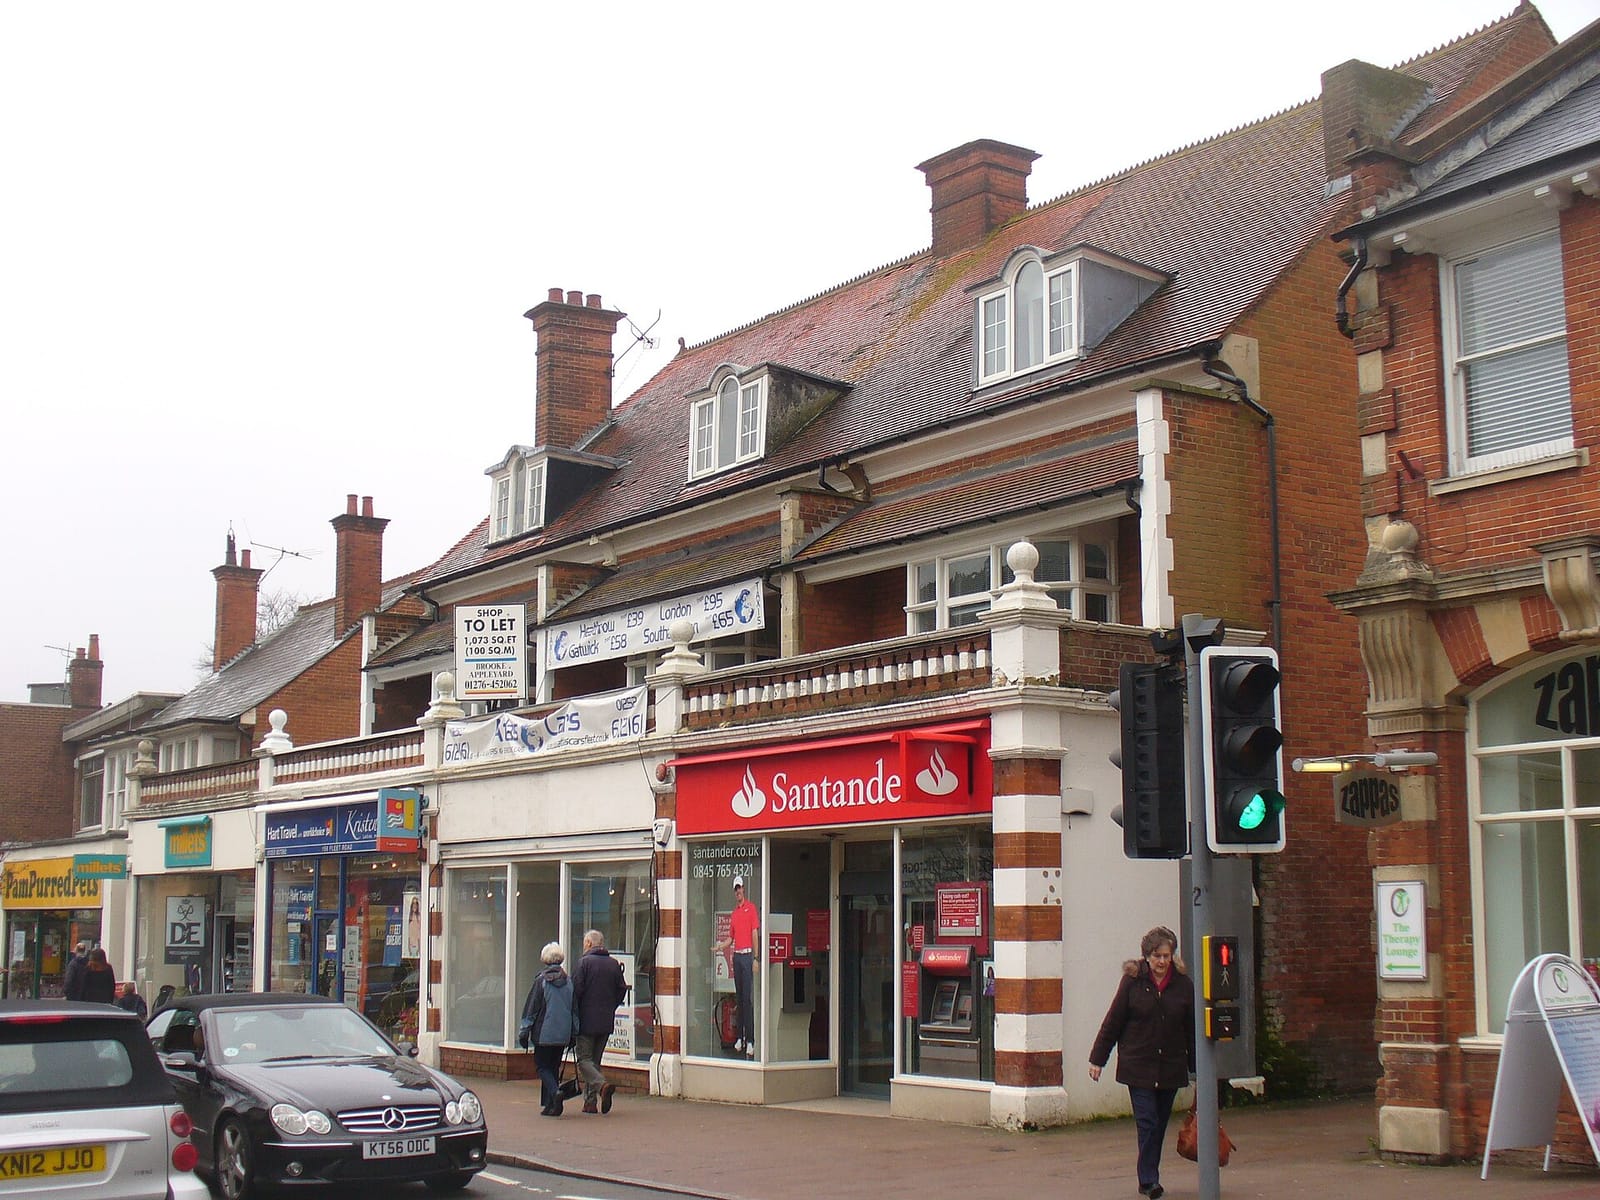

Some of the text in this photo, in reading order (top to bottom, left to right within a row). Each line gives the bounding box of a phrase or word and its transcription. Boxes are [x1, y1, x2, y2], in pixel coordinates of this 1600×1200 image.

[477, 609, 503, 617] SHOP
[626, 610, 645, 629] £39
[659, 602, 692, 621] London
[703, 592, 724, 612] £95
[464, 618, 516, 632] TO LET
[464, 635, 517, 645] 1,073 SQ.FT
[568, 640, 600, 659] Gatwick
[609, 634, 628, 651] £58
[643, 621, 700, 645] Southan
[711, 610, 735, 630] £65
[465, 646, 515, 656] (100 SQ.M)
[469, 671, 514, 679] APPLEYARD
[464, 679, 518, 689] 01276-452062
[771, 758, 903, 813] Santande
[1341, 777, 1400, 819] zappas
[267, 826, 280, 841] Hart
[280, 824, 298, 840] Travel
[693, 843, 760, 859] santander.co.uk
[693, 863, 753, 878] 0845 765 4321
[1193, 886, 1202, 906] 2
[1392, 923, 1410, 932] The
[1382, 934, 1420, 946] Therapy
[936, 952, 962, 961] Santander
[1386, 948, 1418, 959] Lounge
[369, 1139, 430, 1156] KT56 ODC
[0, 1149, 94, 1177] KN12 JJO
